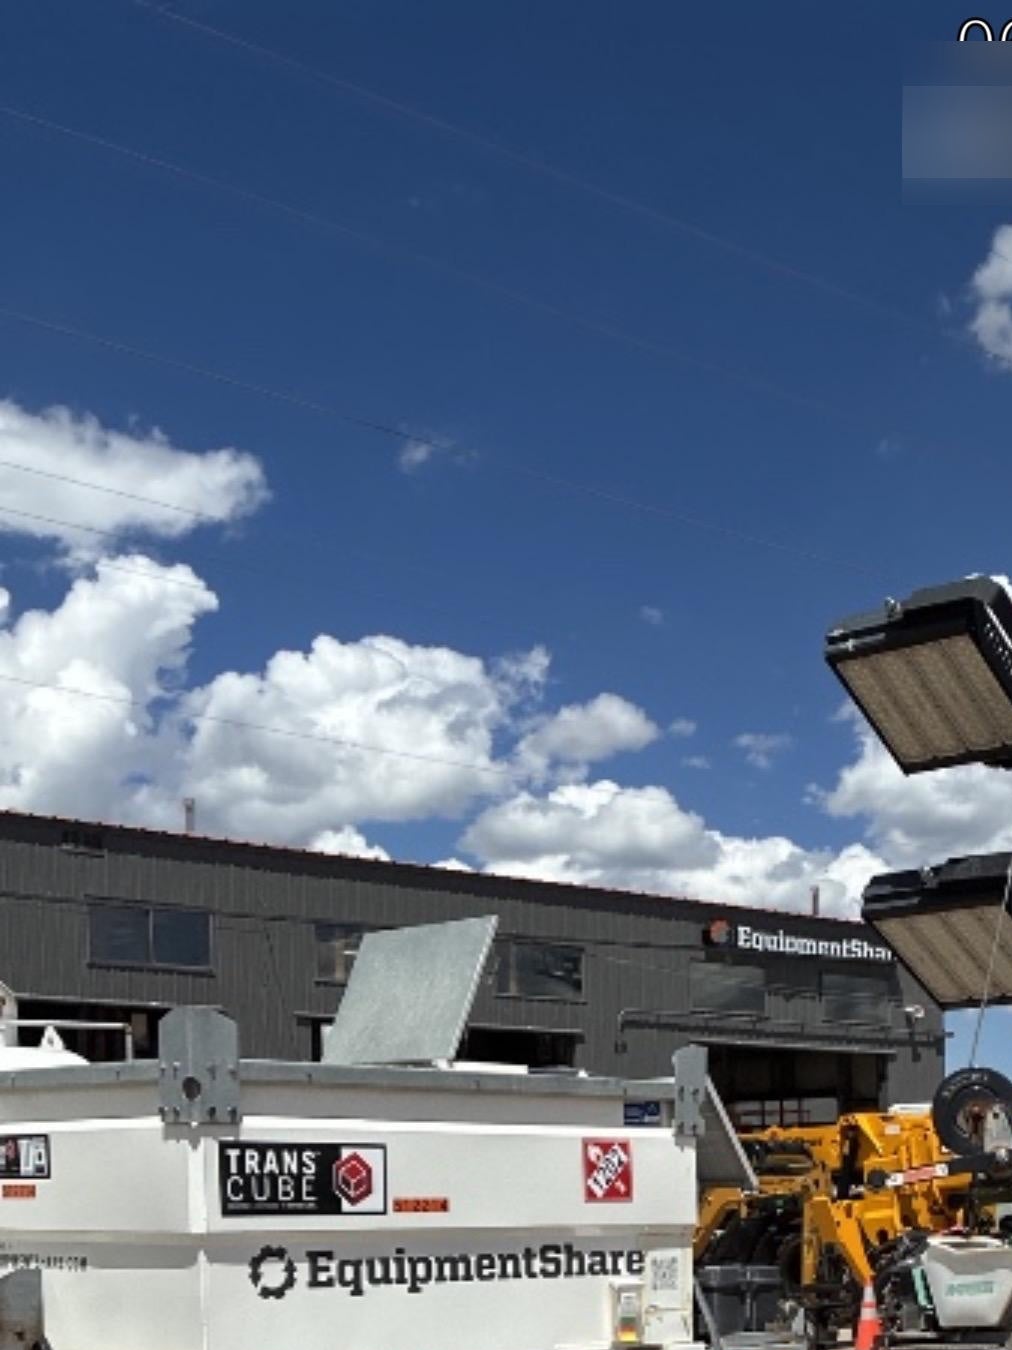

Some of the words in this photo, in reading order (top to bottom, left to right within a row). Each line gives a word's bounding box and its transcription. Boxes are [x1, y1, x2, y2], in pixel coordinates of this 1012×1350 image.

[225, 1148, 317, 1175] TRANS
[227, 1176, 318, 1201] CUBE
[306, 1244, 646, 1297] EquipmentShare
